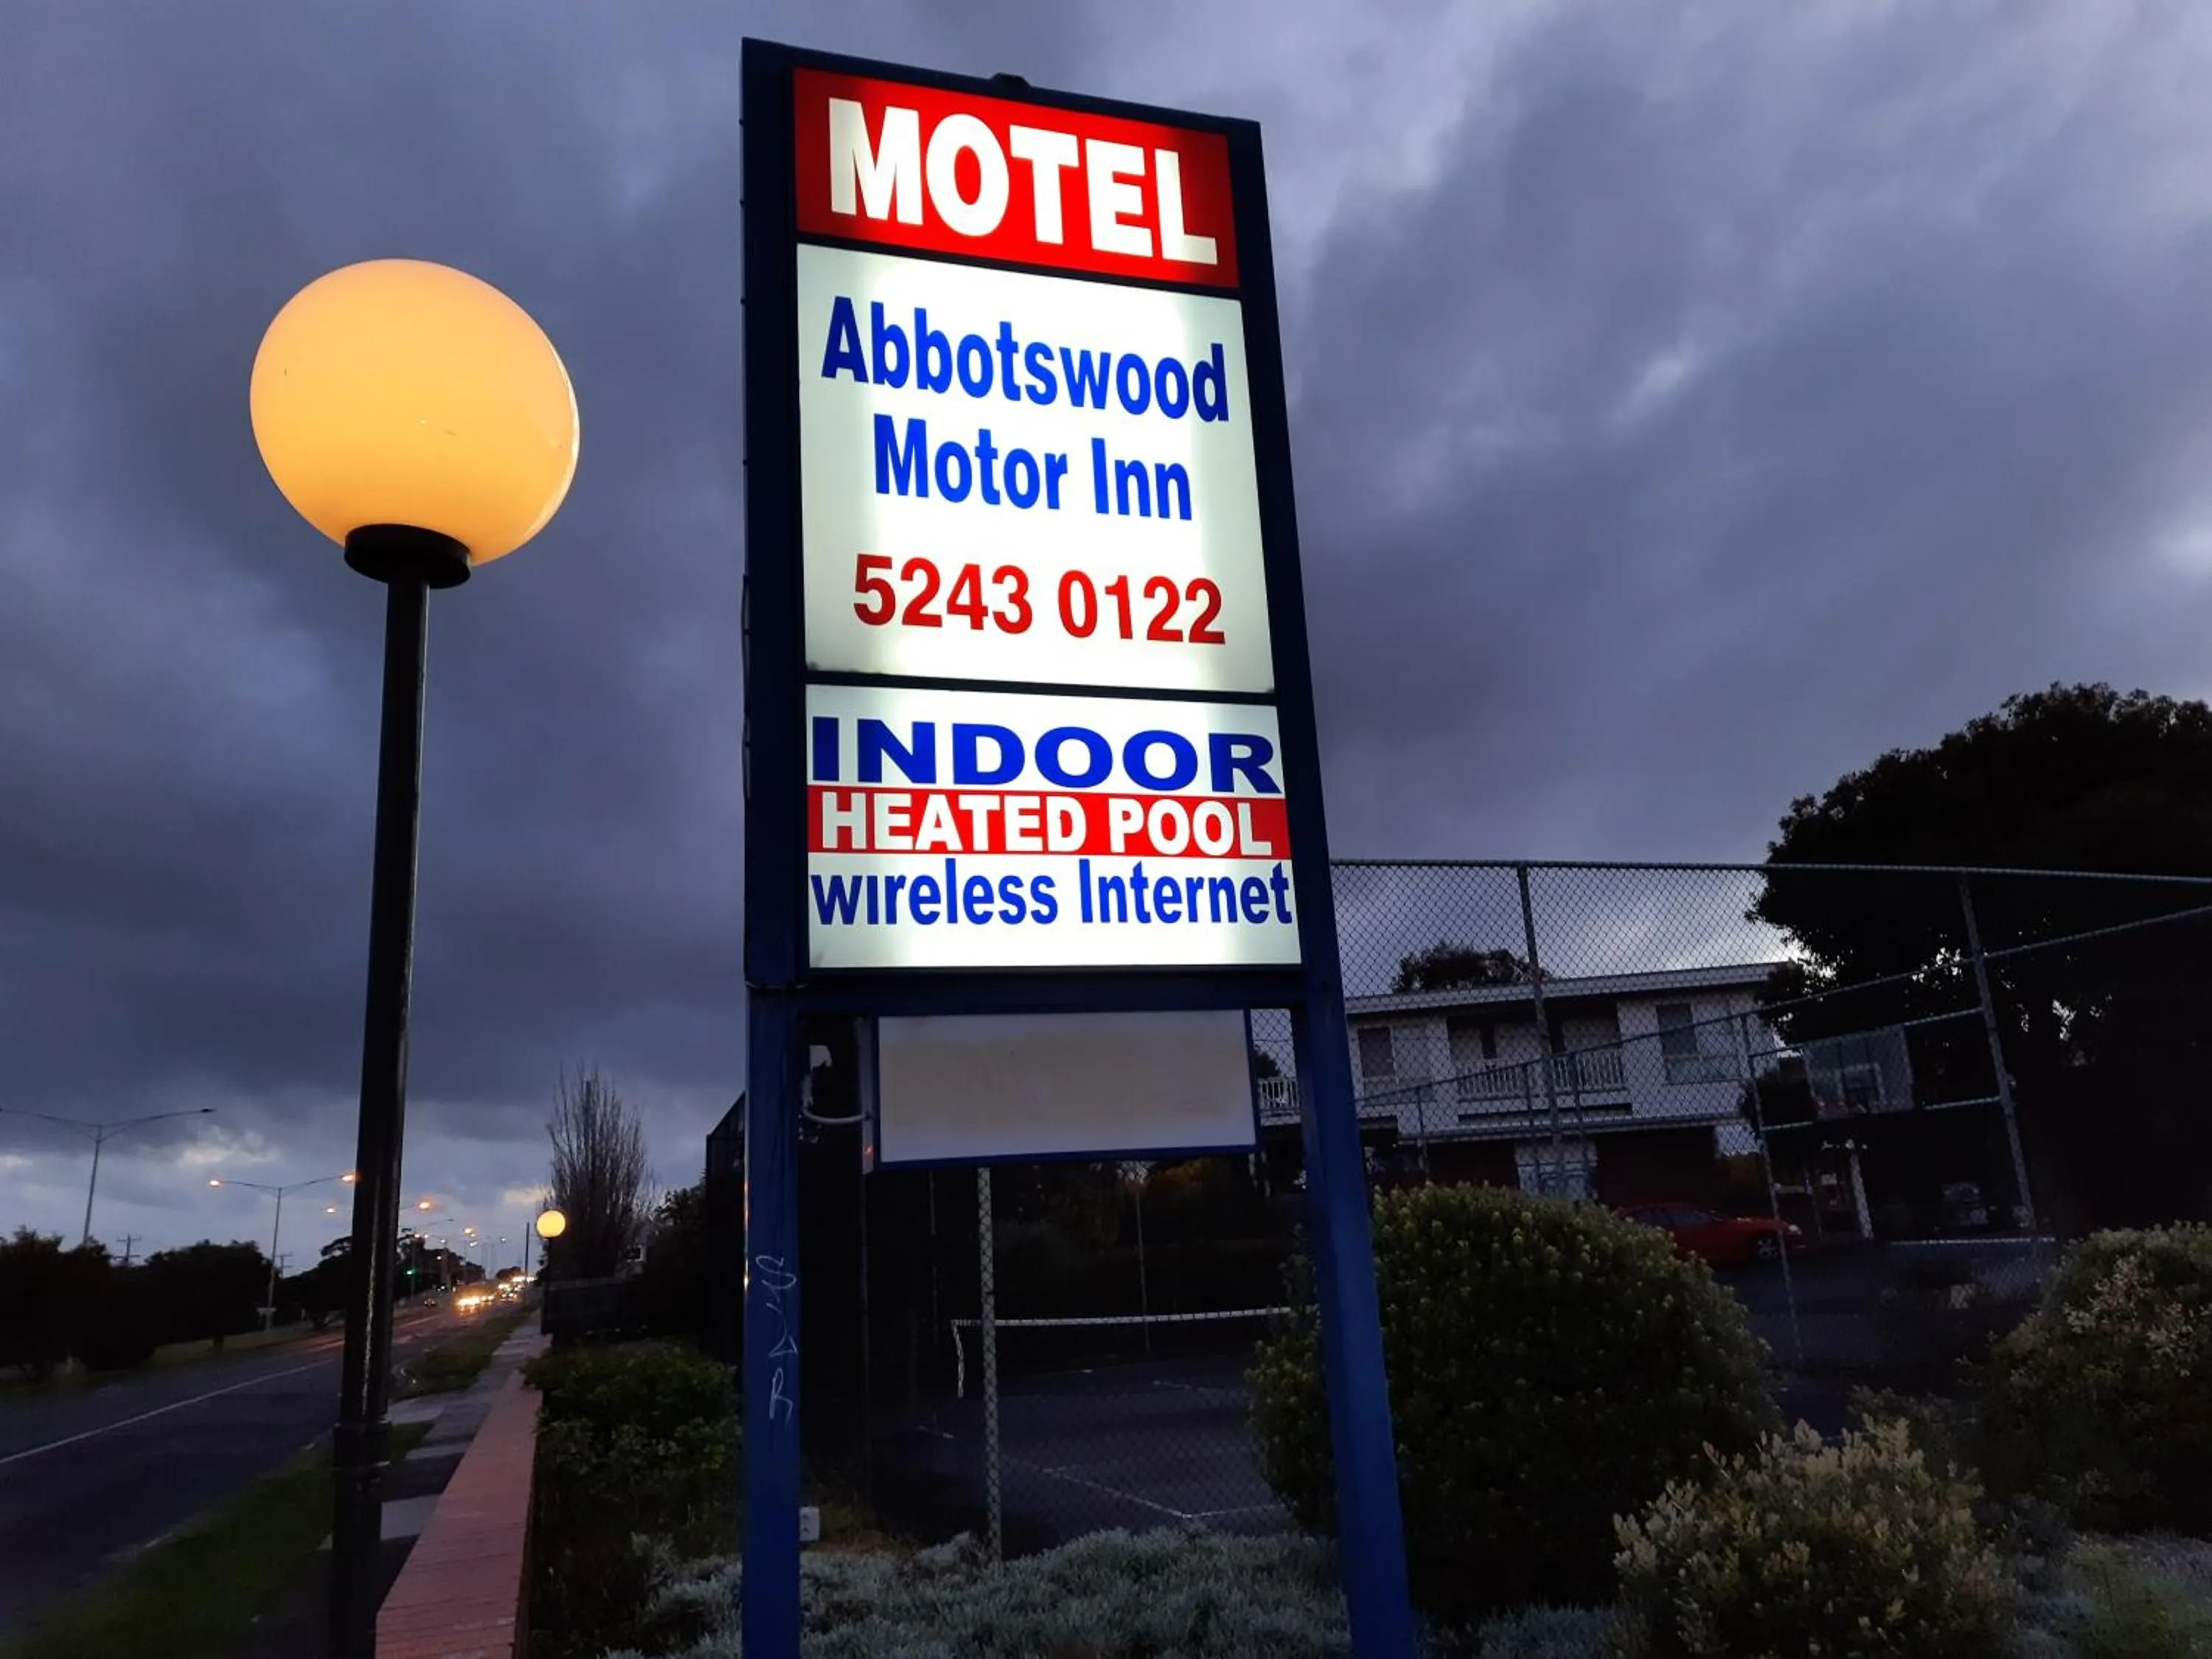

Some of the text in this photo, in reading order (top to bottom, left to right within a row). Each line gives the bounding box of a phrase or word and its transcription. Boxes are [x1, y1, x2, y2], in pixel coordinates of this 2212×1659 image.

[828, 97, 1217, 265] MOTEL
[821, 296, 1229, 422] Abbotswood
[873, 413, 1192, 521] Motor Inn
[852, 554, 1225, 645] 5243 0122
[812, 717, 1282, 794] INDOOR
[821, 791, 1272, 856] HEATED POOL
[811, 857, 1293, 925] wireless Internet
